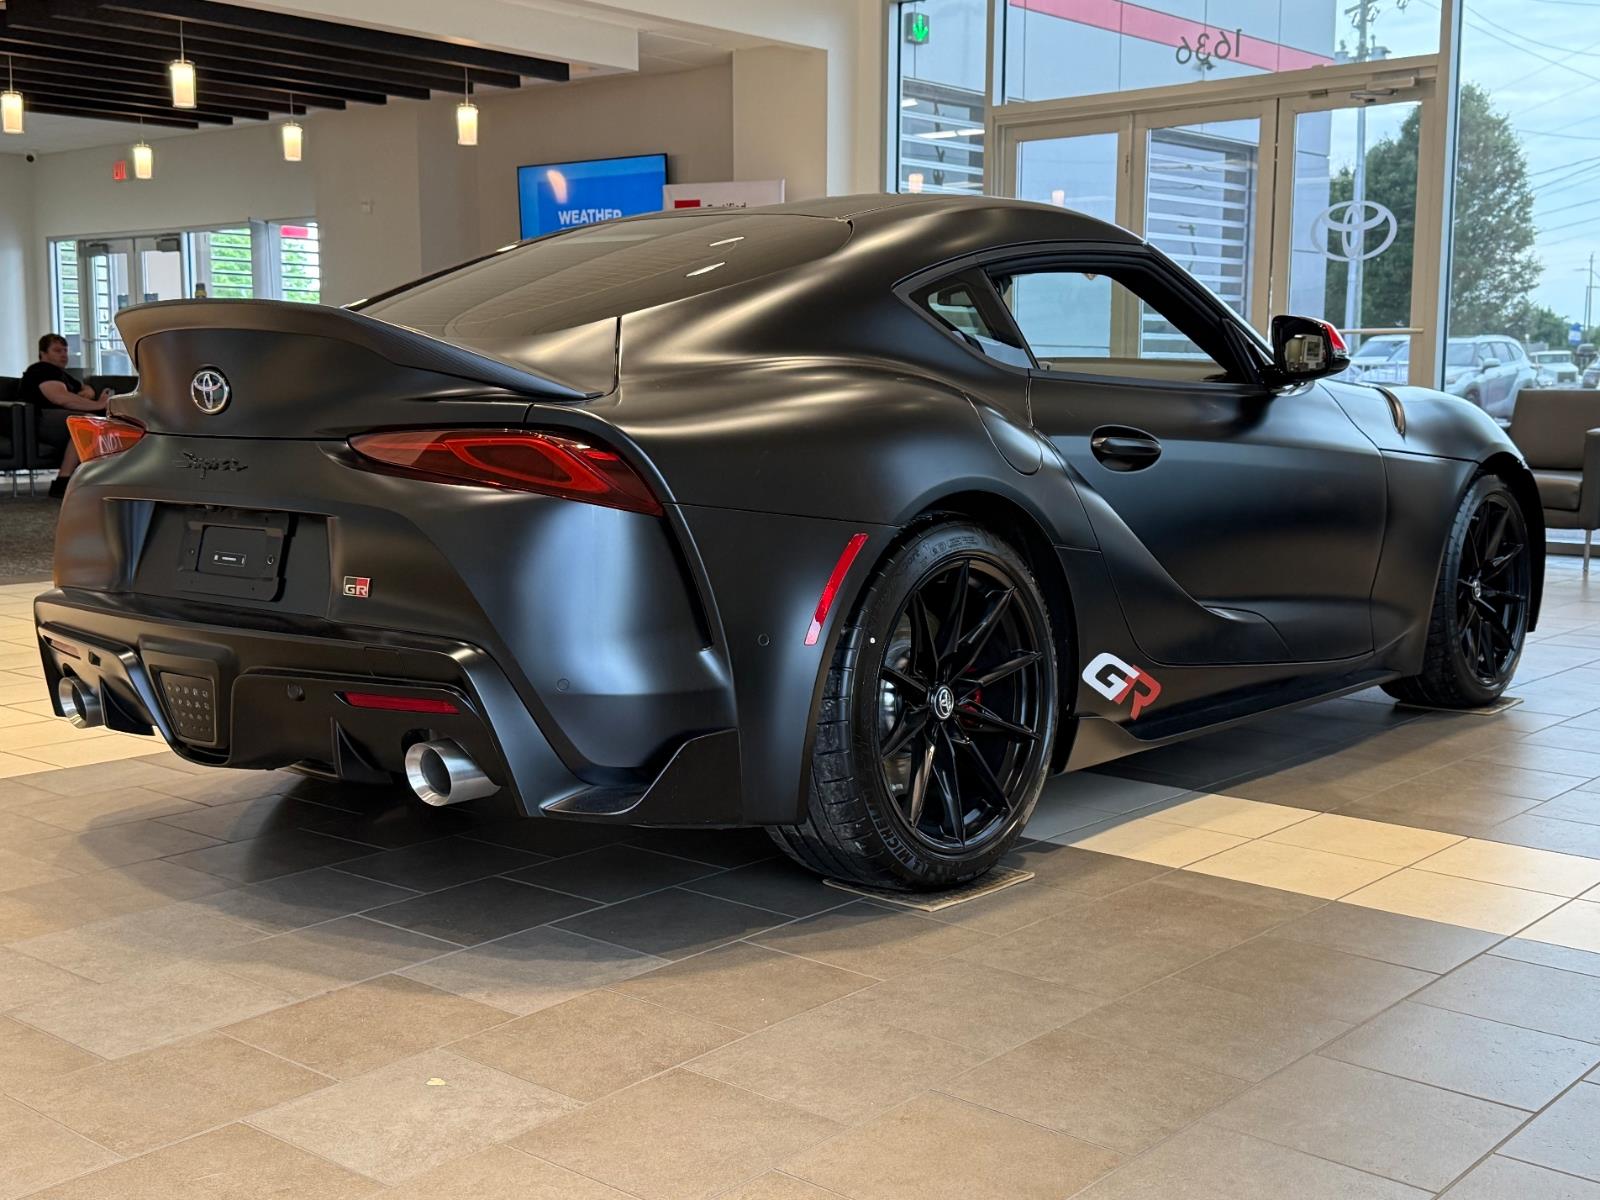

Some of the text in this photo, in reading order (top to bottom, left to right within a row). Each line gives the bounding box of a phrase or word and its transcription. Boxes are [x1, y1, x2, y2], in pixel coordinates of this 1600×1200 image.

[558, 208, 622, 225] WEATHER
[345, 584, 367, 596] GR
[1081, 652, 1162, 721] GR
